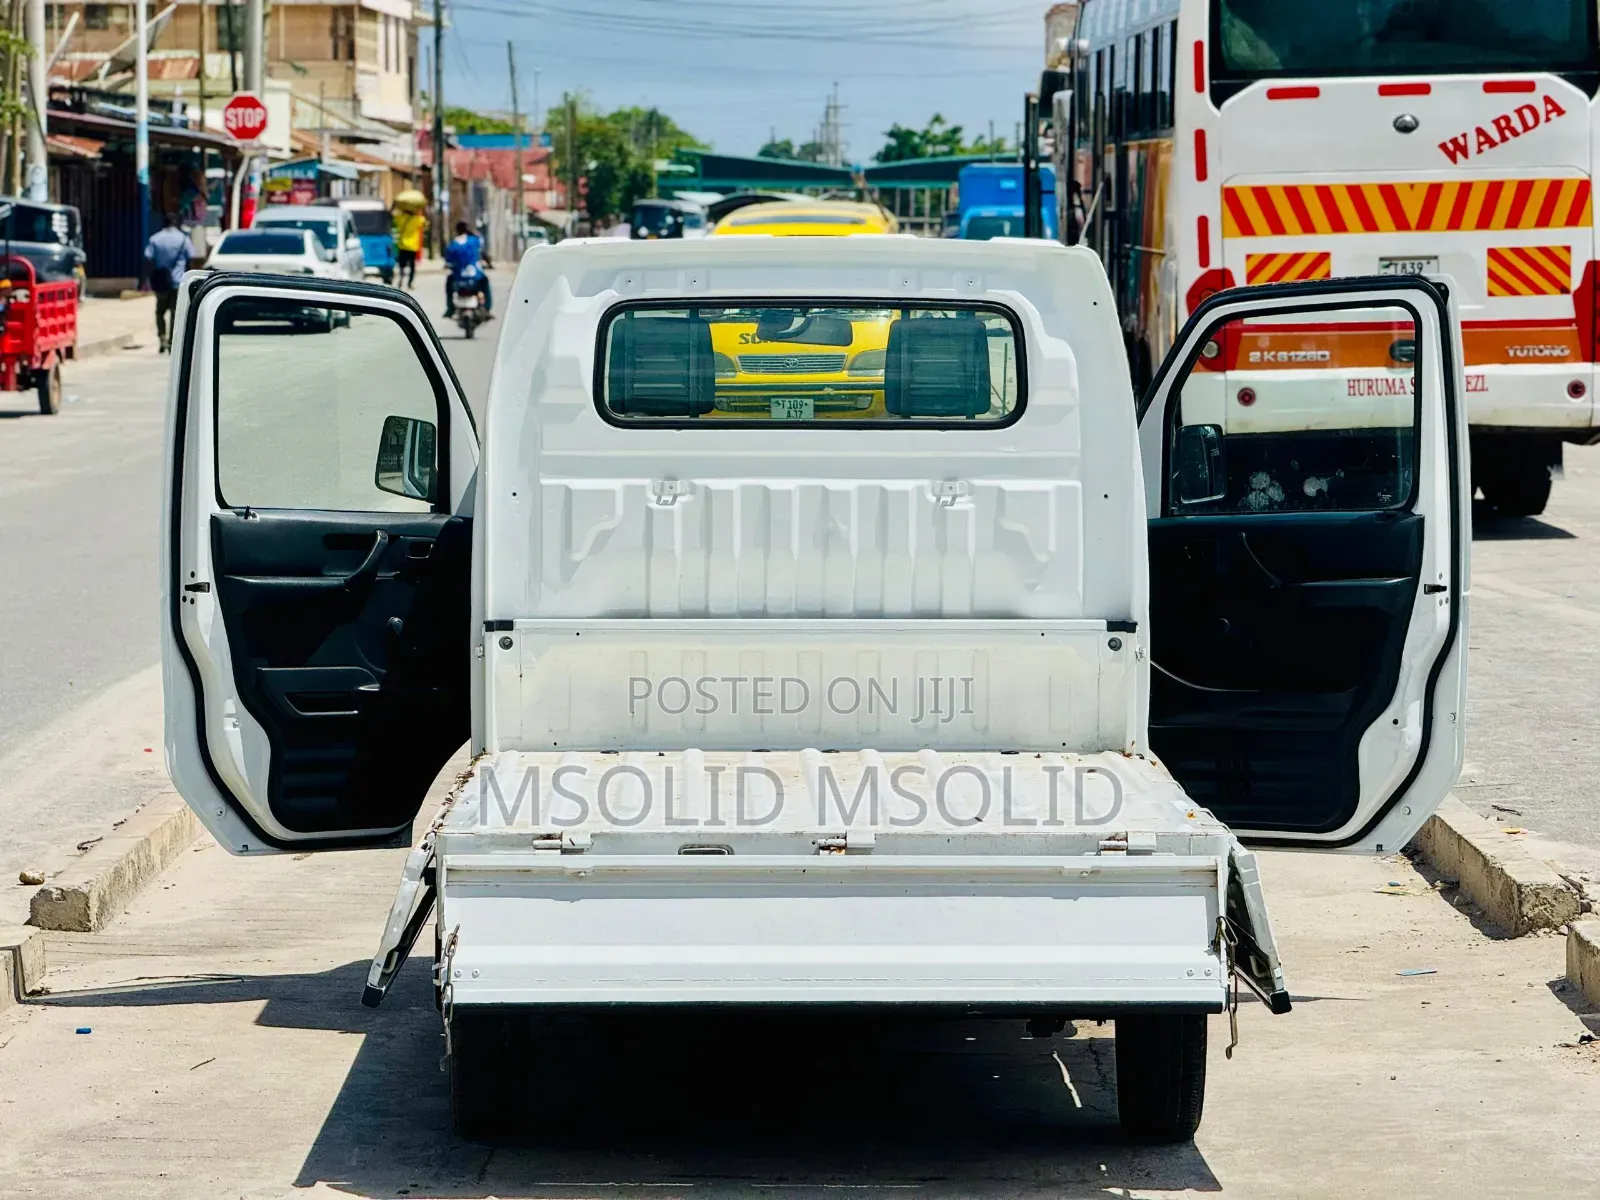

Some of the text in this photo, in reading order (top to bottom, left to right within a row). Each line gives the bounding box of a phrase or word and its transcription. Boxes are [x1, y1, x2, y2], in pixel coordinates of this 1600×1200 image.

[226, 107, 266, 130] STOP
[1438, 94, 1567, 165] WARDA
[1505, 345, 1571, 357] YUTONG
[1347, 377, 1407, 396] HURUMA
